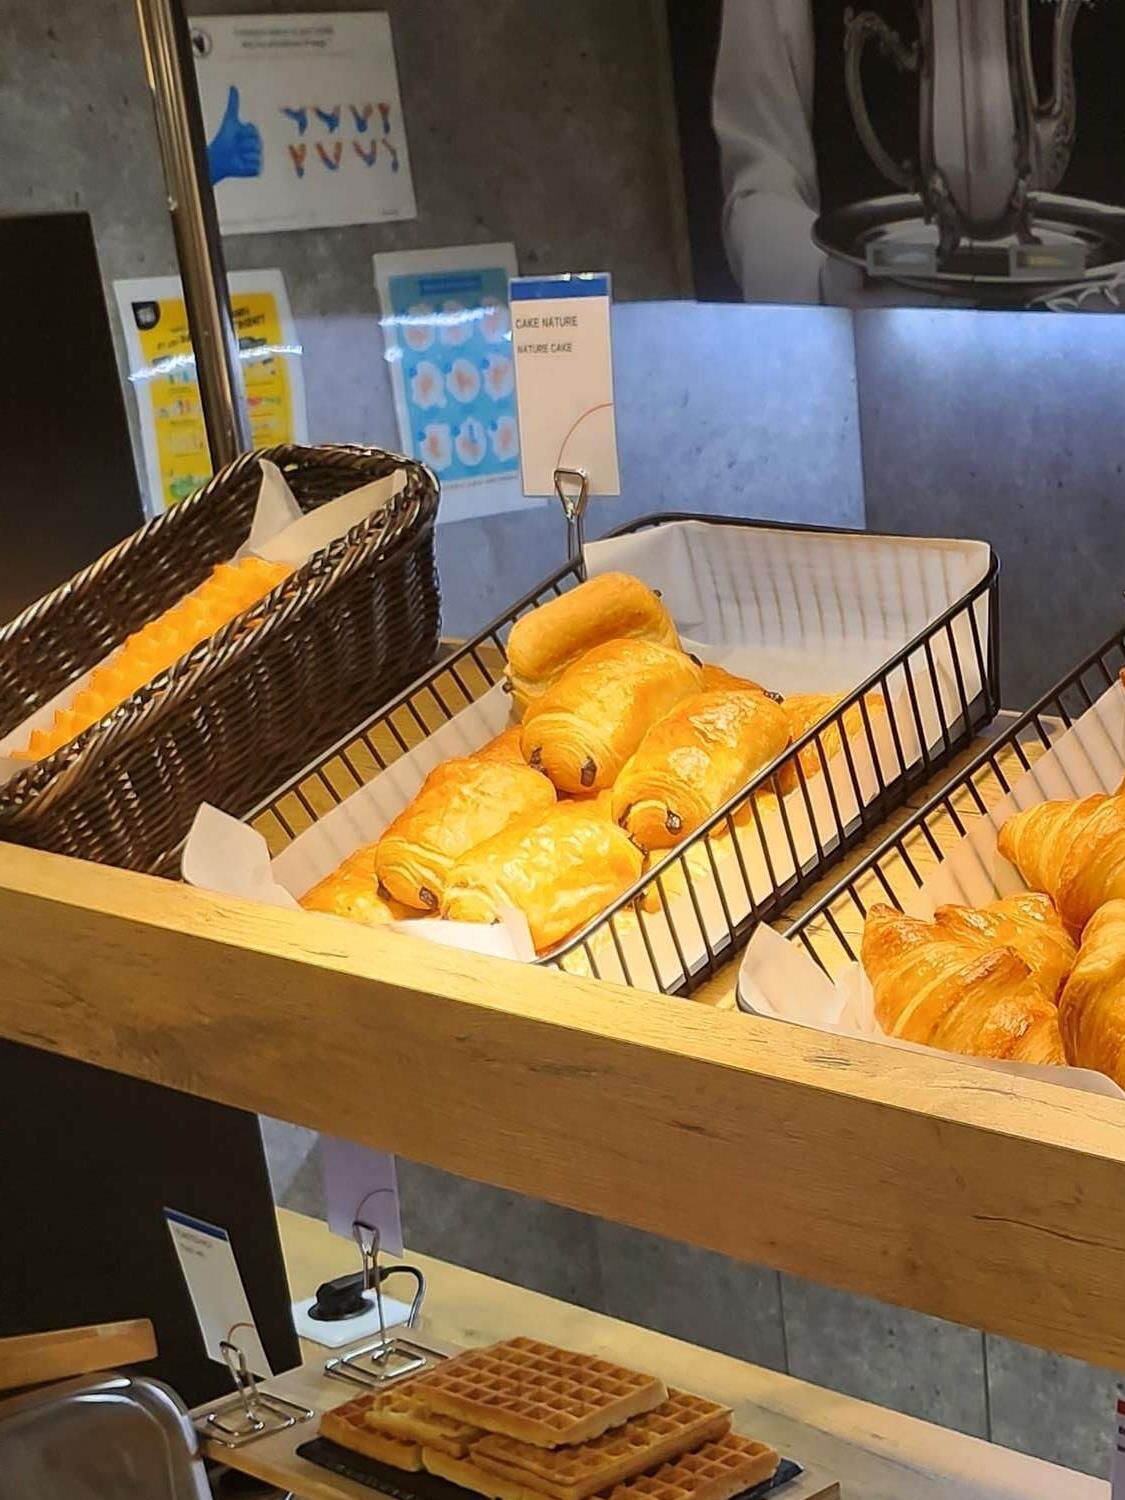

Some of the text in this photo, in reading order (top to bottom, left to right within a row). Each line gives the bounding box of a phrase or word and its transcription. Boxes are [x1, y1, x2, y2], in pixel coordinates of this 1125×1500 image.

[515, 316, 577, 329] CAKE NATURE
[517, 343, 572, 353] NATURE CAKE
